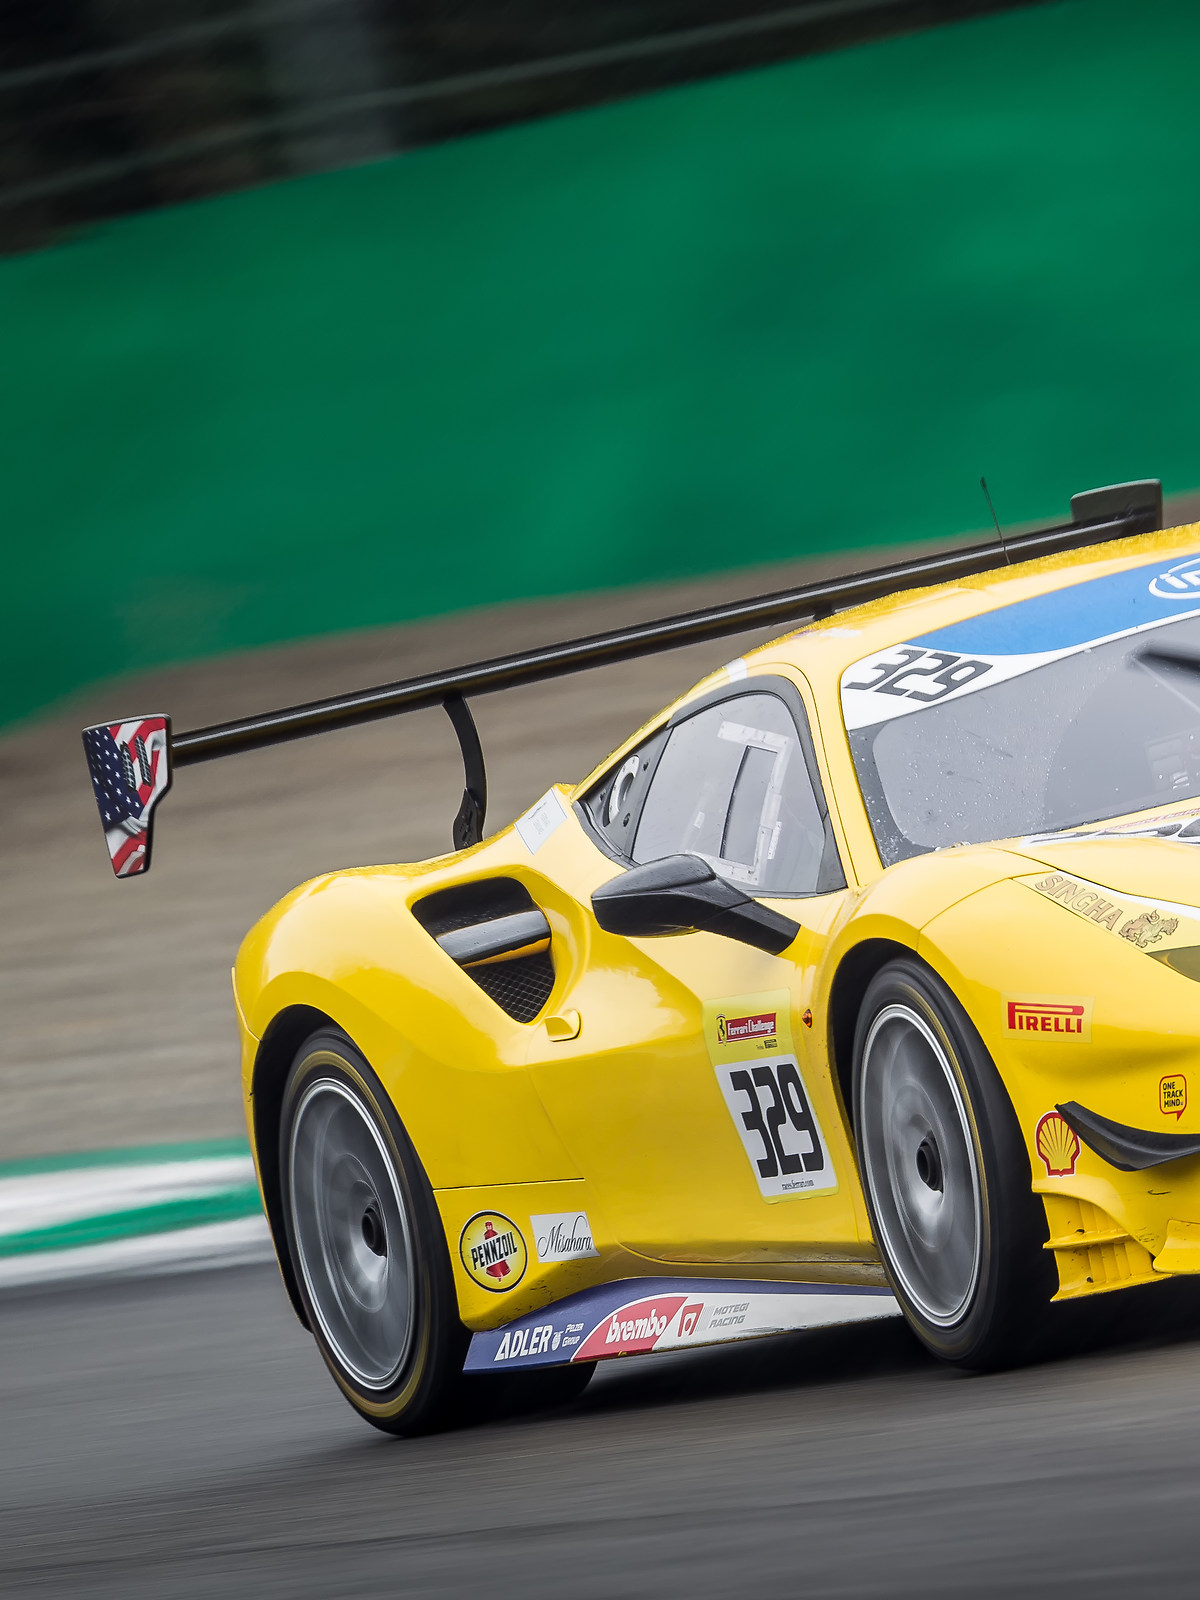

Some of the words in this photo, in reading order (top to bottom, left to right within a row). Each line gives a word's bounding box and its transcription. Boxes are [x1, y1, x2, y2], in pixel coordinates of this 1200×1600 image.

[843, 649, 994, 702] 329
[1035, 874, 1124, 931] SINGHA
[728, 1022, 748, 1036] Ferrari
[748, 1018, 774, 1033] Challenge
[1007, 1001, 1084, 1033] PIRELLI
[1162, 1081, 1176, 1090] ONE
[1163, 1089, 1183, 1099] TRACK
[1164, 1098, 1181, 1108] MIND
[729, 1063, 824, 1178] 329
[471, 1232, 518, 1271] PENNZOIL
[537, 1215, 592, 1258] Misahara
[709, 1314, 746, 1328] RACING
[713, 1302, 749, 1316] MOTEGI
[494, 1324, 553, 1361] ADLER
[605, 1309, 667, 1343] brembo
